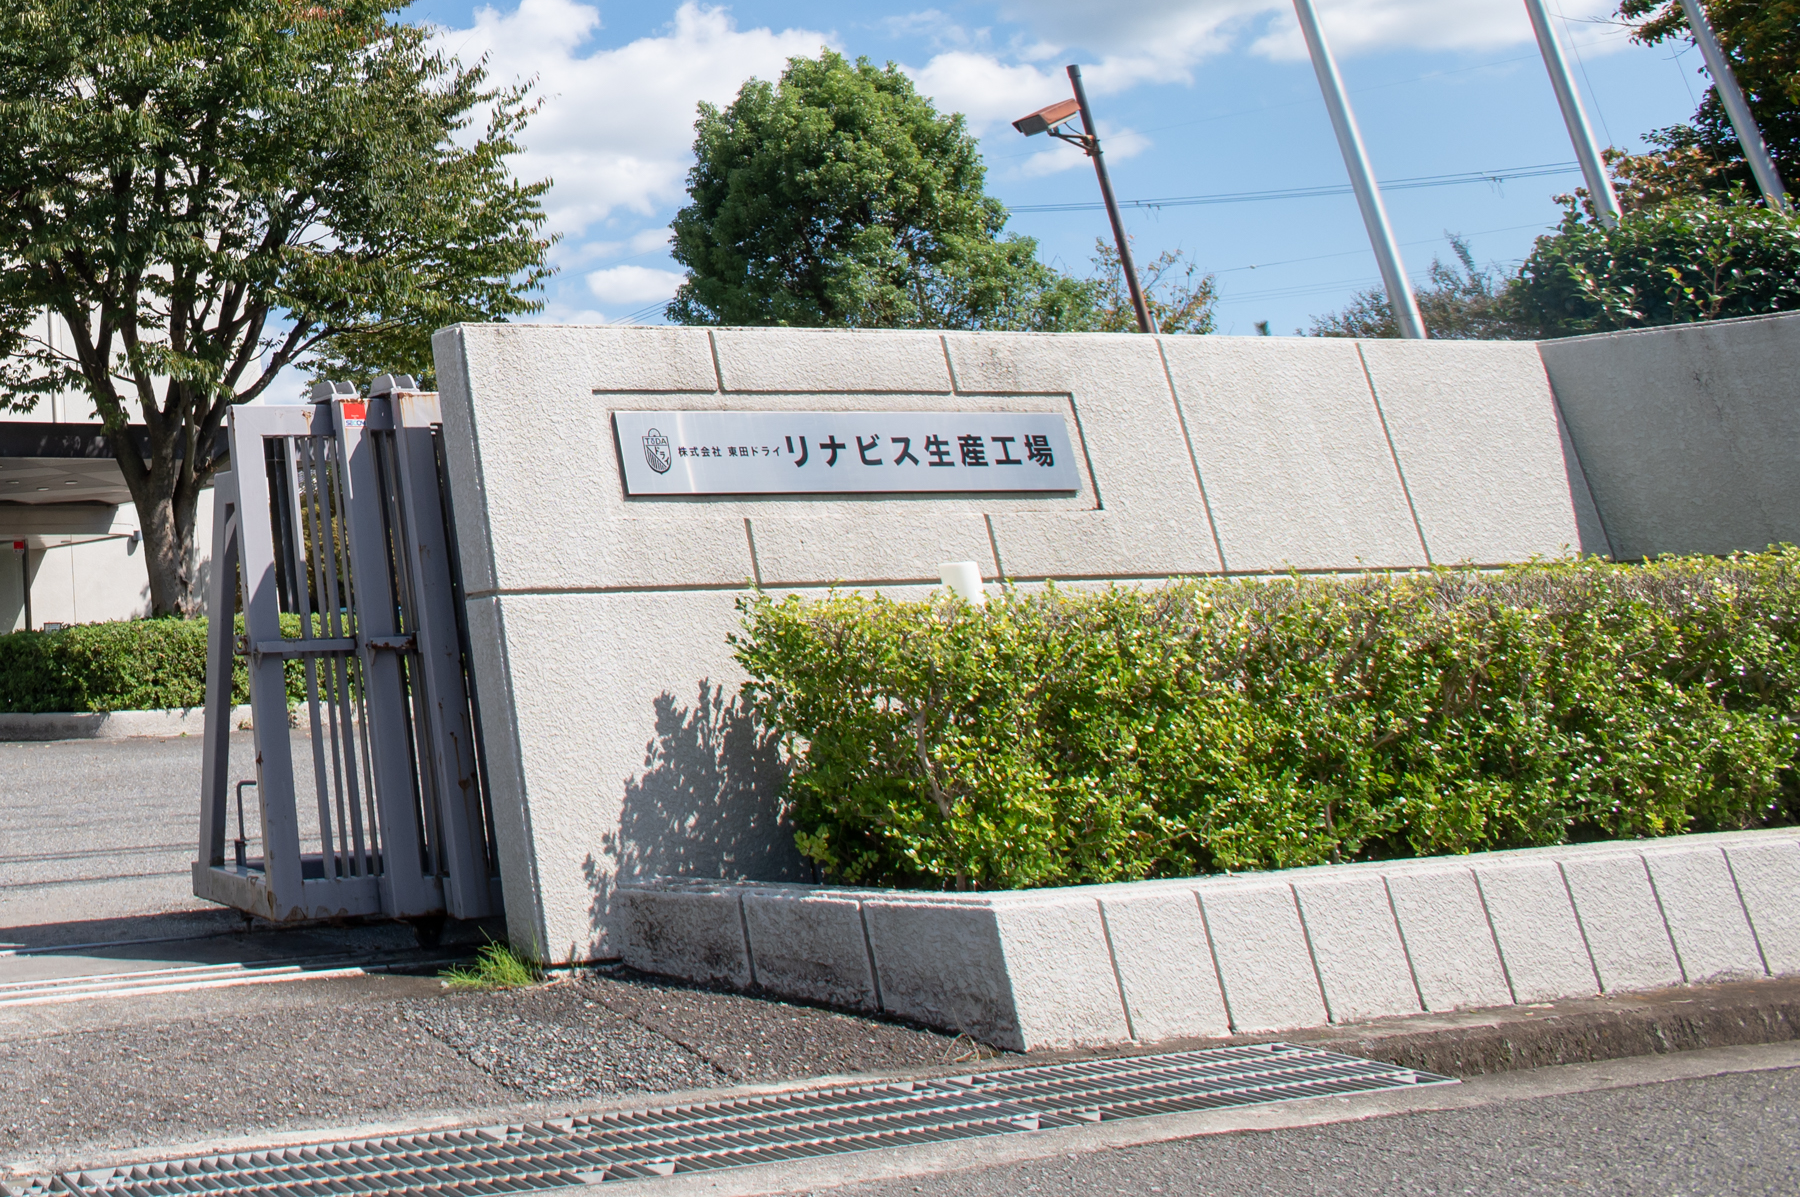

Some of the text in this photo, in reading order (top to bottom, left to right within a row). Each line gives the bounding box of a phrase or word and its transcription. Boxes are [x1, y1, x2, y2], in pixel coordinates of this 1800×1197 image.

[678, 433, 1055, 469] 株式会社 東田ドライ リナビス生産工場
